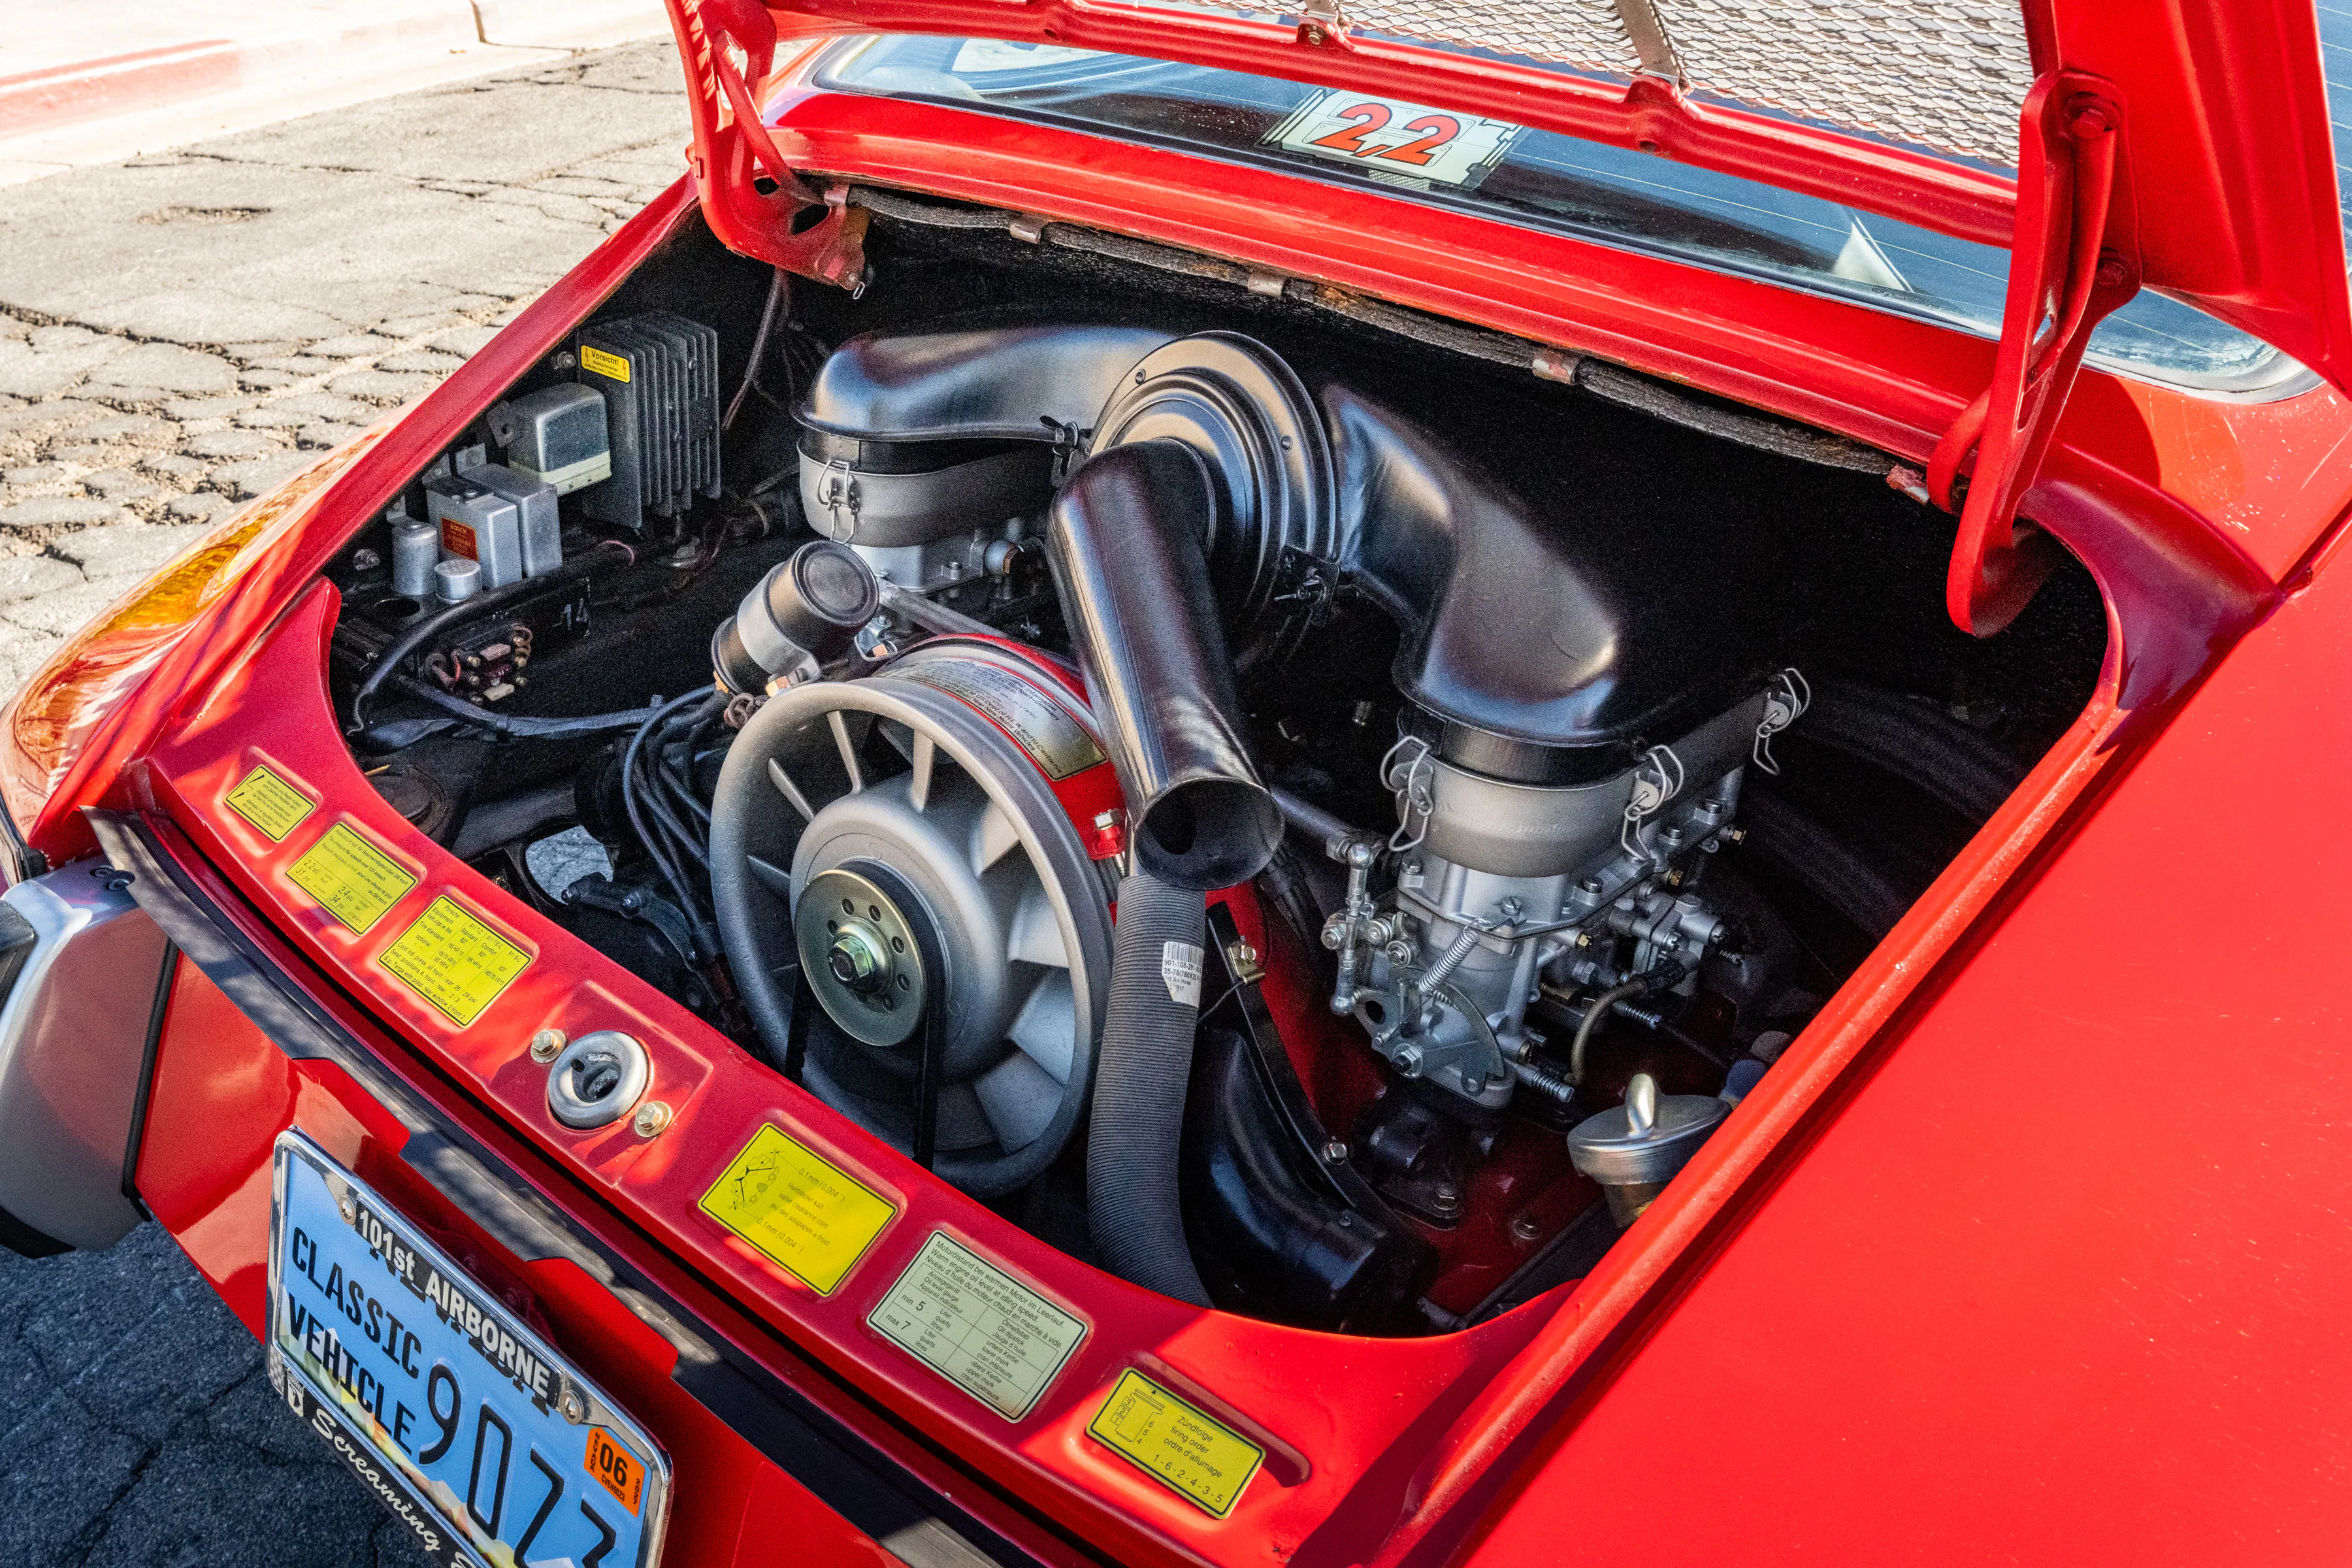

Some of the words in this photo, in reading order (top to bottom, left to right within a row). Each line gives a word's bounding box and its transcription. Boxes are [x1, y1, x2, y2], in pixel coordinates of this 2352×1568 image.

[591, 350, 619, 365] Vorsicht!
[1025, 688, 1059, 711] Information
[996, 715, 1015, 728] Motor
[1013, 728, 1036, 751] Vehicles
[1037, 744, 1062, 774] California
[329, 894, 341, 903] 34
[444, 904, 460, 919] Porsche
[415, 934, 432, 947] optional
[419, 921, 427, 930] Tire
[426, 927, 444, 941] standard
[432, 907, 454, 924] Equipment
[460, 927, 479, 942] Standard
[481, 942, 497, 956] Comfort
[397, 941, 409, 952] Cold
[432, 968, 444, 978] front
[400, 957, 421, 973] positions
[424, 974, 436, 985] front
[436, 984, 446, 992] rear
[392, 961, 404, 973] Targa
[403, 971, 413, 980] with
[432, 993, 448, 1007] window
[450, 1007, 463, 1017] front
[779, 1192, 792, 1204] valve
[792, 1202, 817, 1221] clearance
[816, 1218, 829, 1229] cold
[787, 1181, 815, 1203] Ventilspiel
[813, 1199, 824, 1210] kalt
[768, 1201, 779, 1211] jeu
[778, 1208, 789, 1218] des
[788, 1215, 813, 1235] soupapes
[817, 1233, 830, 1246] froid
[292, 1226, 422, 1379] CLASSIC
[360, 1210, 416, 1282] 101st
[425, 1269, 550, 1398] AIRBORNE
[924, 1254, 945, 1271] Niveau
[964, 1282, 973, 1290] du
[972, 1287, 994, 1303] moteur
[992, 1301, 1013, 1315] chaud
[1011, 1313, 1021, 1321] en
[1019, 1318, 1043, 1335] marche
[1048, 1336, 1062, 1349] vide.
[928, 1271, 960, 1294] Anzeigegerät
[1002, 1318, 1030, 1340] Ölmeßstab
[930, 1247, 949, 1264] Warm
[949, 1261, 970, 1277] engine
[977, 1279, 994, 1292] level
[1000, 1293, 1018, 1310] idling
[1017, 1305, 1039, 1322] speed.
[935, 1240, 975, 1269] Motorölstand
[973, 1265, 985, 1276] bei
[984, 1273, 1009, 1292] warmen
[1009, 1288, 1028, 1303] Motor
[1027, 1300, 1037, 1310] im
[1036, 1305, 1064, 1328] Leerlauf.
[901, 1294, 913, 1305] min
[916, 1301, 926, 1311] 5
[939, 1308, 952, 1318] Liter
[986, 1340, 1003, 1354] untere
[1002, 1350, 1019, 1364] Kerbe
[919, 1282, 940, 1298] Appareil
[939, 1295, 963, 1314] indicateur
[992, 1331, 1009, 1345] Jauge
[924, 1276, 933, 1284] Oil
[930, 1281, 944, 1292] level
[942, 1290, 959, 1303] gauge
[997, 1325, 1006, 1333] Oil
[1005, 1331, 1024, 1347] dipstick
[885, 1314, 900, 1326] max
[901, 1320, 911, 1330] 7
[924, 1328, 936, 1339] Liter
[970, 1361, 986, 1373] obere
[985, 1369, 1002, 1384] Kerbe
[919, 1335, 936, 1348] quarts
[965, 1367, 981, 1379] upper
[980, 1377, 994, 1388] mark
[930, 1320, 943, 1331] litres
[976, 1352, 989, 1363] cran
[988, 1360, 1013, 1379] inférieure
[935, 1315, 951, 1328] quarts
[981, 1345, 996, 1358] lower
[995, 1356, 1009, 1367] mark
[289, 1292, 416, 1455] VEHICLE
[915, 1340, 928, 1352] litres
[960, 1373, 973, 1382] cran
[972, 1380, 1000, 1403] supérieure
[1170, 1426, 1189, 1443] firing
[1188, 1439, 1209, 1454] order
[1177, 1415, 1213, 1442] Zündfolge
[589, 1431, 600, 1473] NEVADA
[600, 1443, 628, 1487] 06
[1163, 1437, 1183, 1452] ordre
[1183, 1450, 1222, 1478] d'allumage
[311, 1407, 441, 1552] Screaming
[601, 1474, 625, 1502] CVEH90Z3
